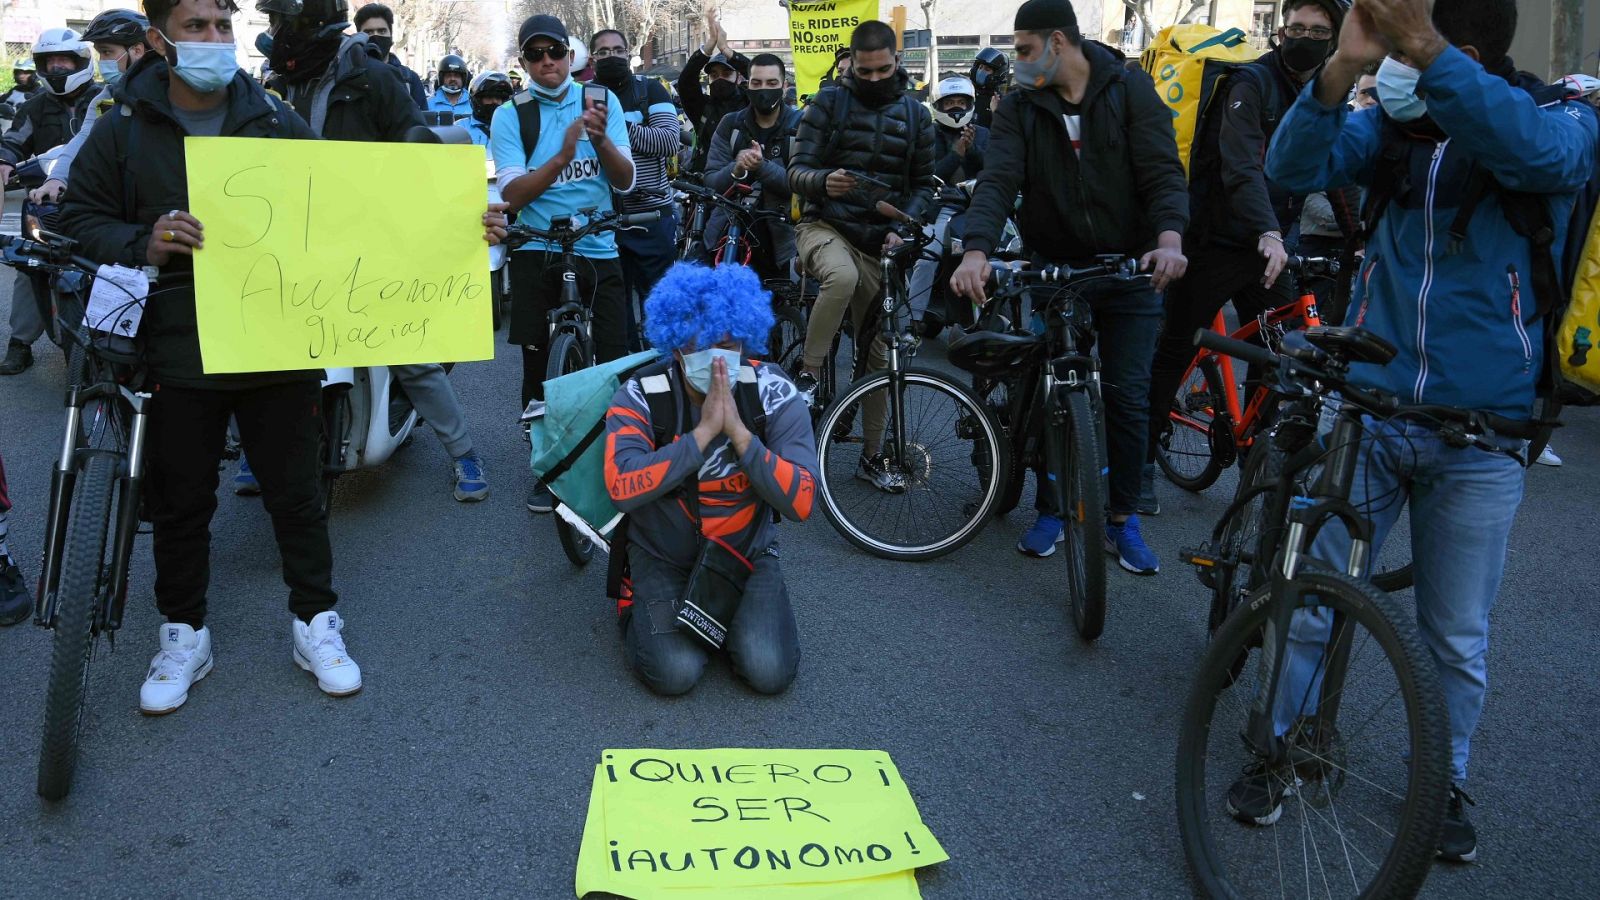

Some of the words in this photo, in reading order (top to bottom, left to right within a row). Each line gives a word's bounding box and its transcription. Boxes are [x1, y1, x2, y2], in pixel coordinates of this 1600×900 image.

[792, 21, 805, 30] Els
[808, 16, 859, 30] RIDERS
[793, 31, 814, 44] NO
[815, 33, 839, 44] SOM
[223, 165, 312, 253] SI
[691, 796, 831, 823] SER
